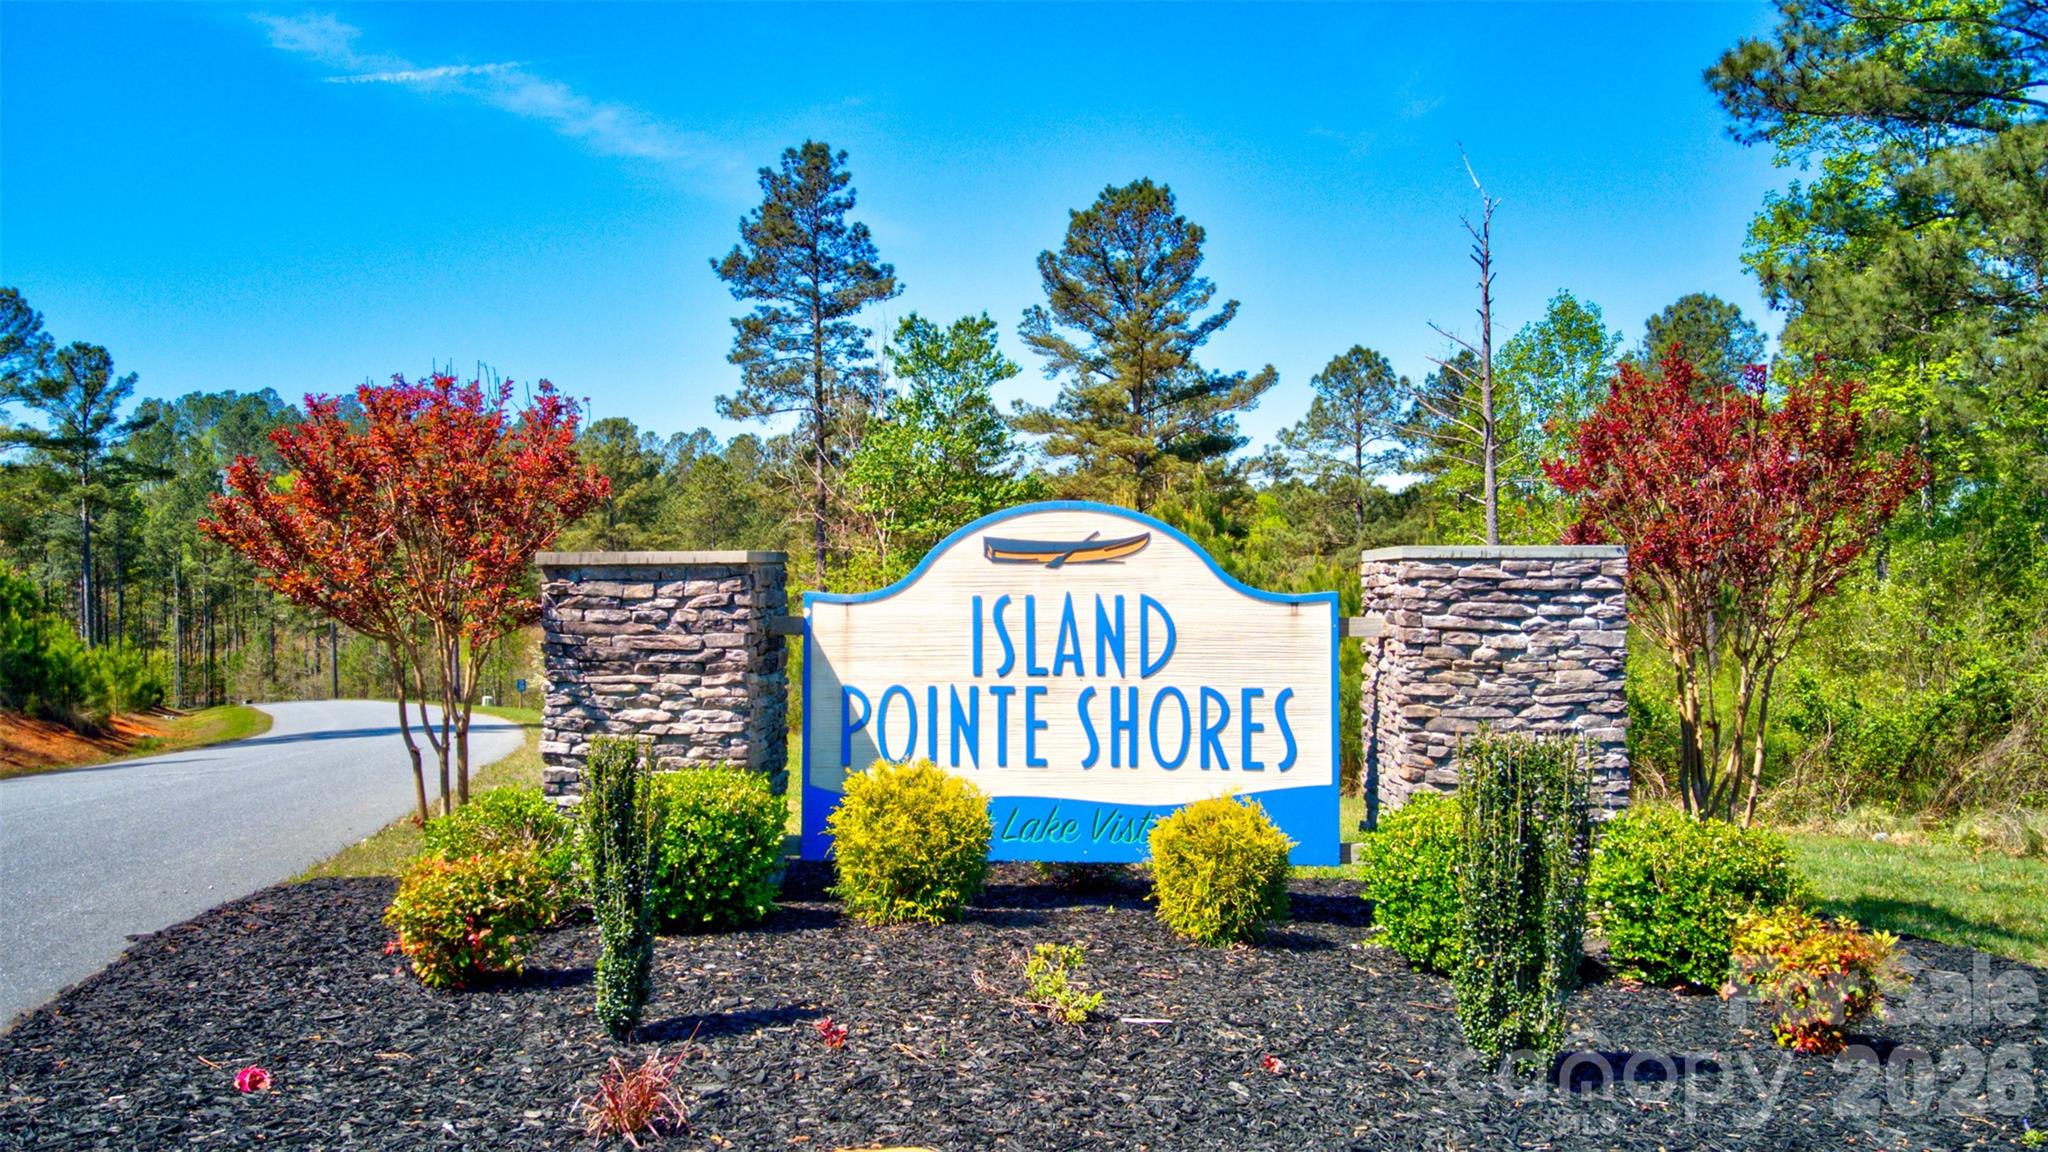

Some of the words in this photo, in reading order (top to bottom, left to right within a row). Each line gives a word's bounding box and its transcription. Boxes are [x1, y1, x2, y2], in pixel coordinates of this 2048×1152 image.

[972, 591, 1177, 679] ISLAND
[841, 683, 1049, 771] POINTE
[1078, 685, 1298, 772] SHORES
[1001, 804, 1080, 844] Lake
[1091, 807, 1158, 845] Vist
